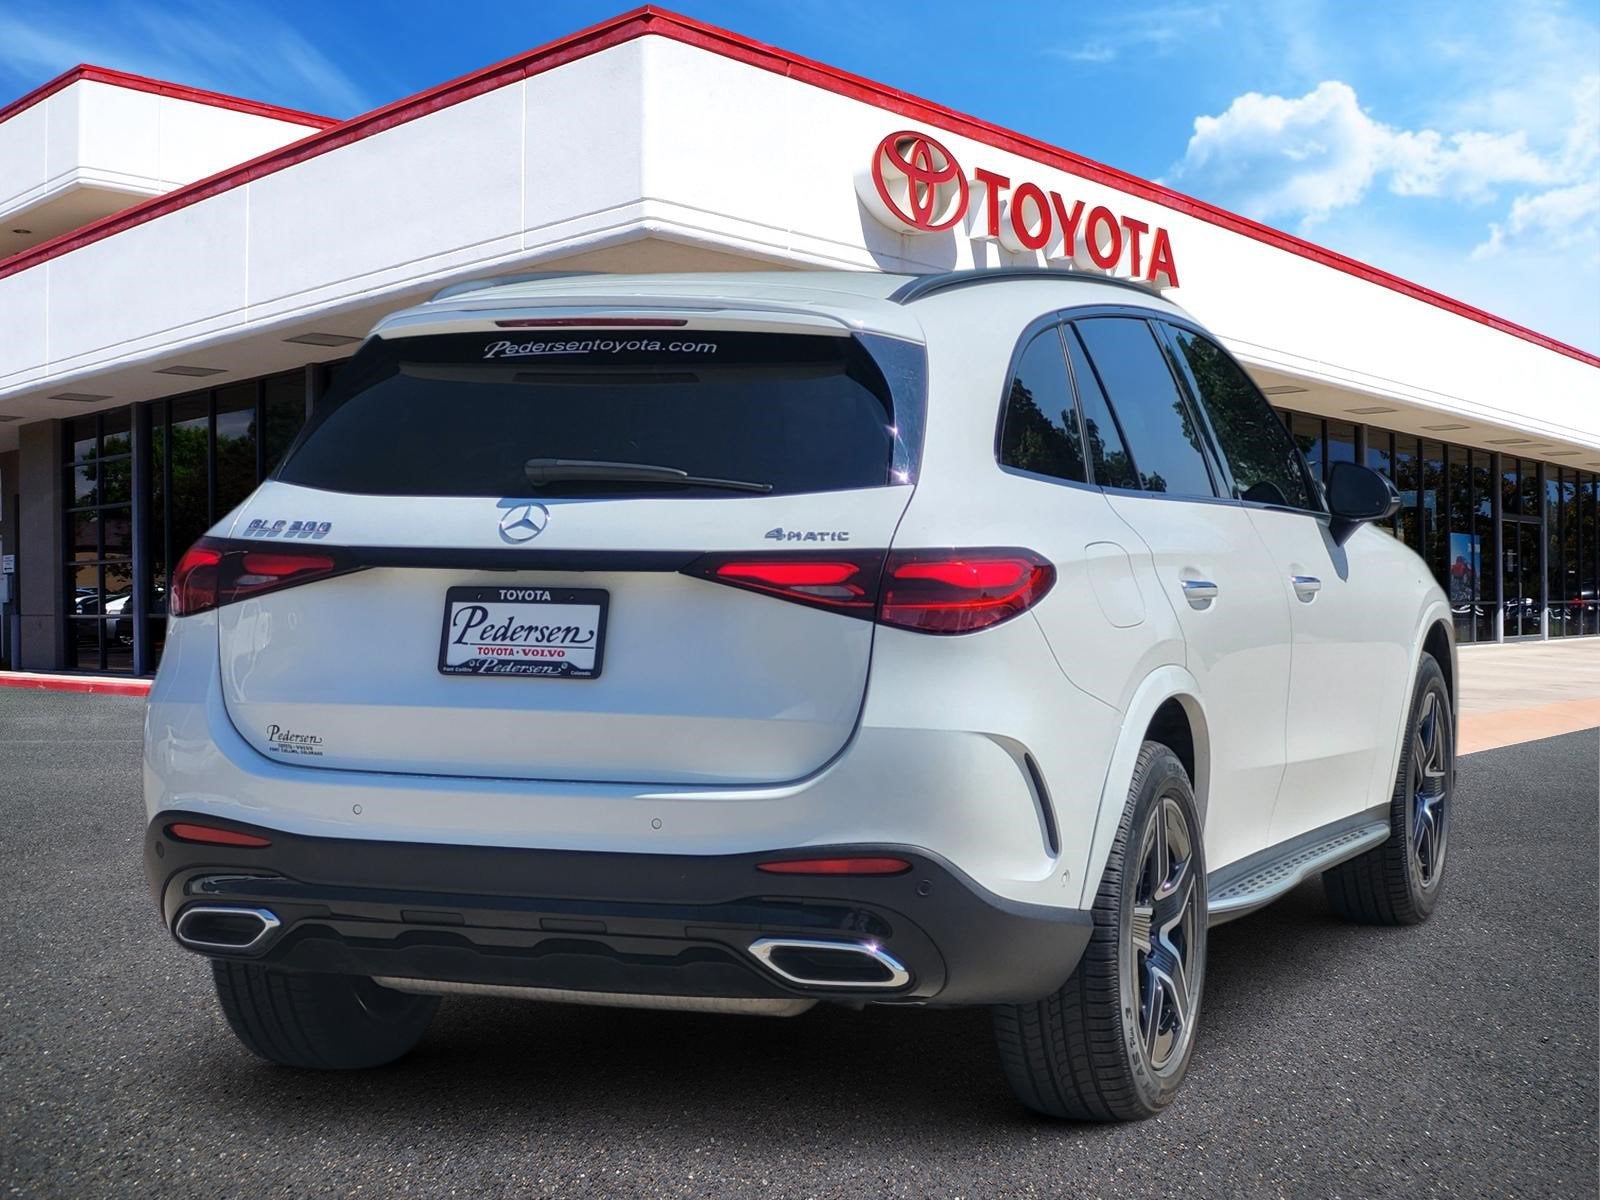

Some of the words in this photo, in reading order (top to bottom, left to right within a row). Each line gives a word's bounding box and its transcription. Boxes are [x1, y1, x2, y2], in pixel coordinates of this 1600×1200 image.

[975, 167, 1180, 288] TOYOTA
[764, 527, 849, 541] 4MATIC
[499, 590, 551, 601] TOYOTA
[453, 605, 594, 646] Pedersen
[478, 647, 515, 656] TOYOTA
[522, 648, 566, 657] VOLVO
[476, 658, 562, 675] Pedersen
[266, 724, 323, 743] Pedersen
